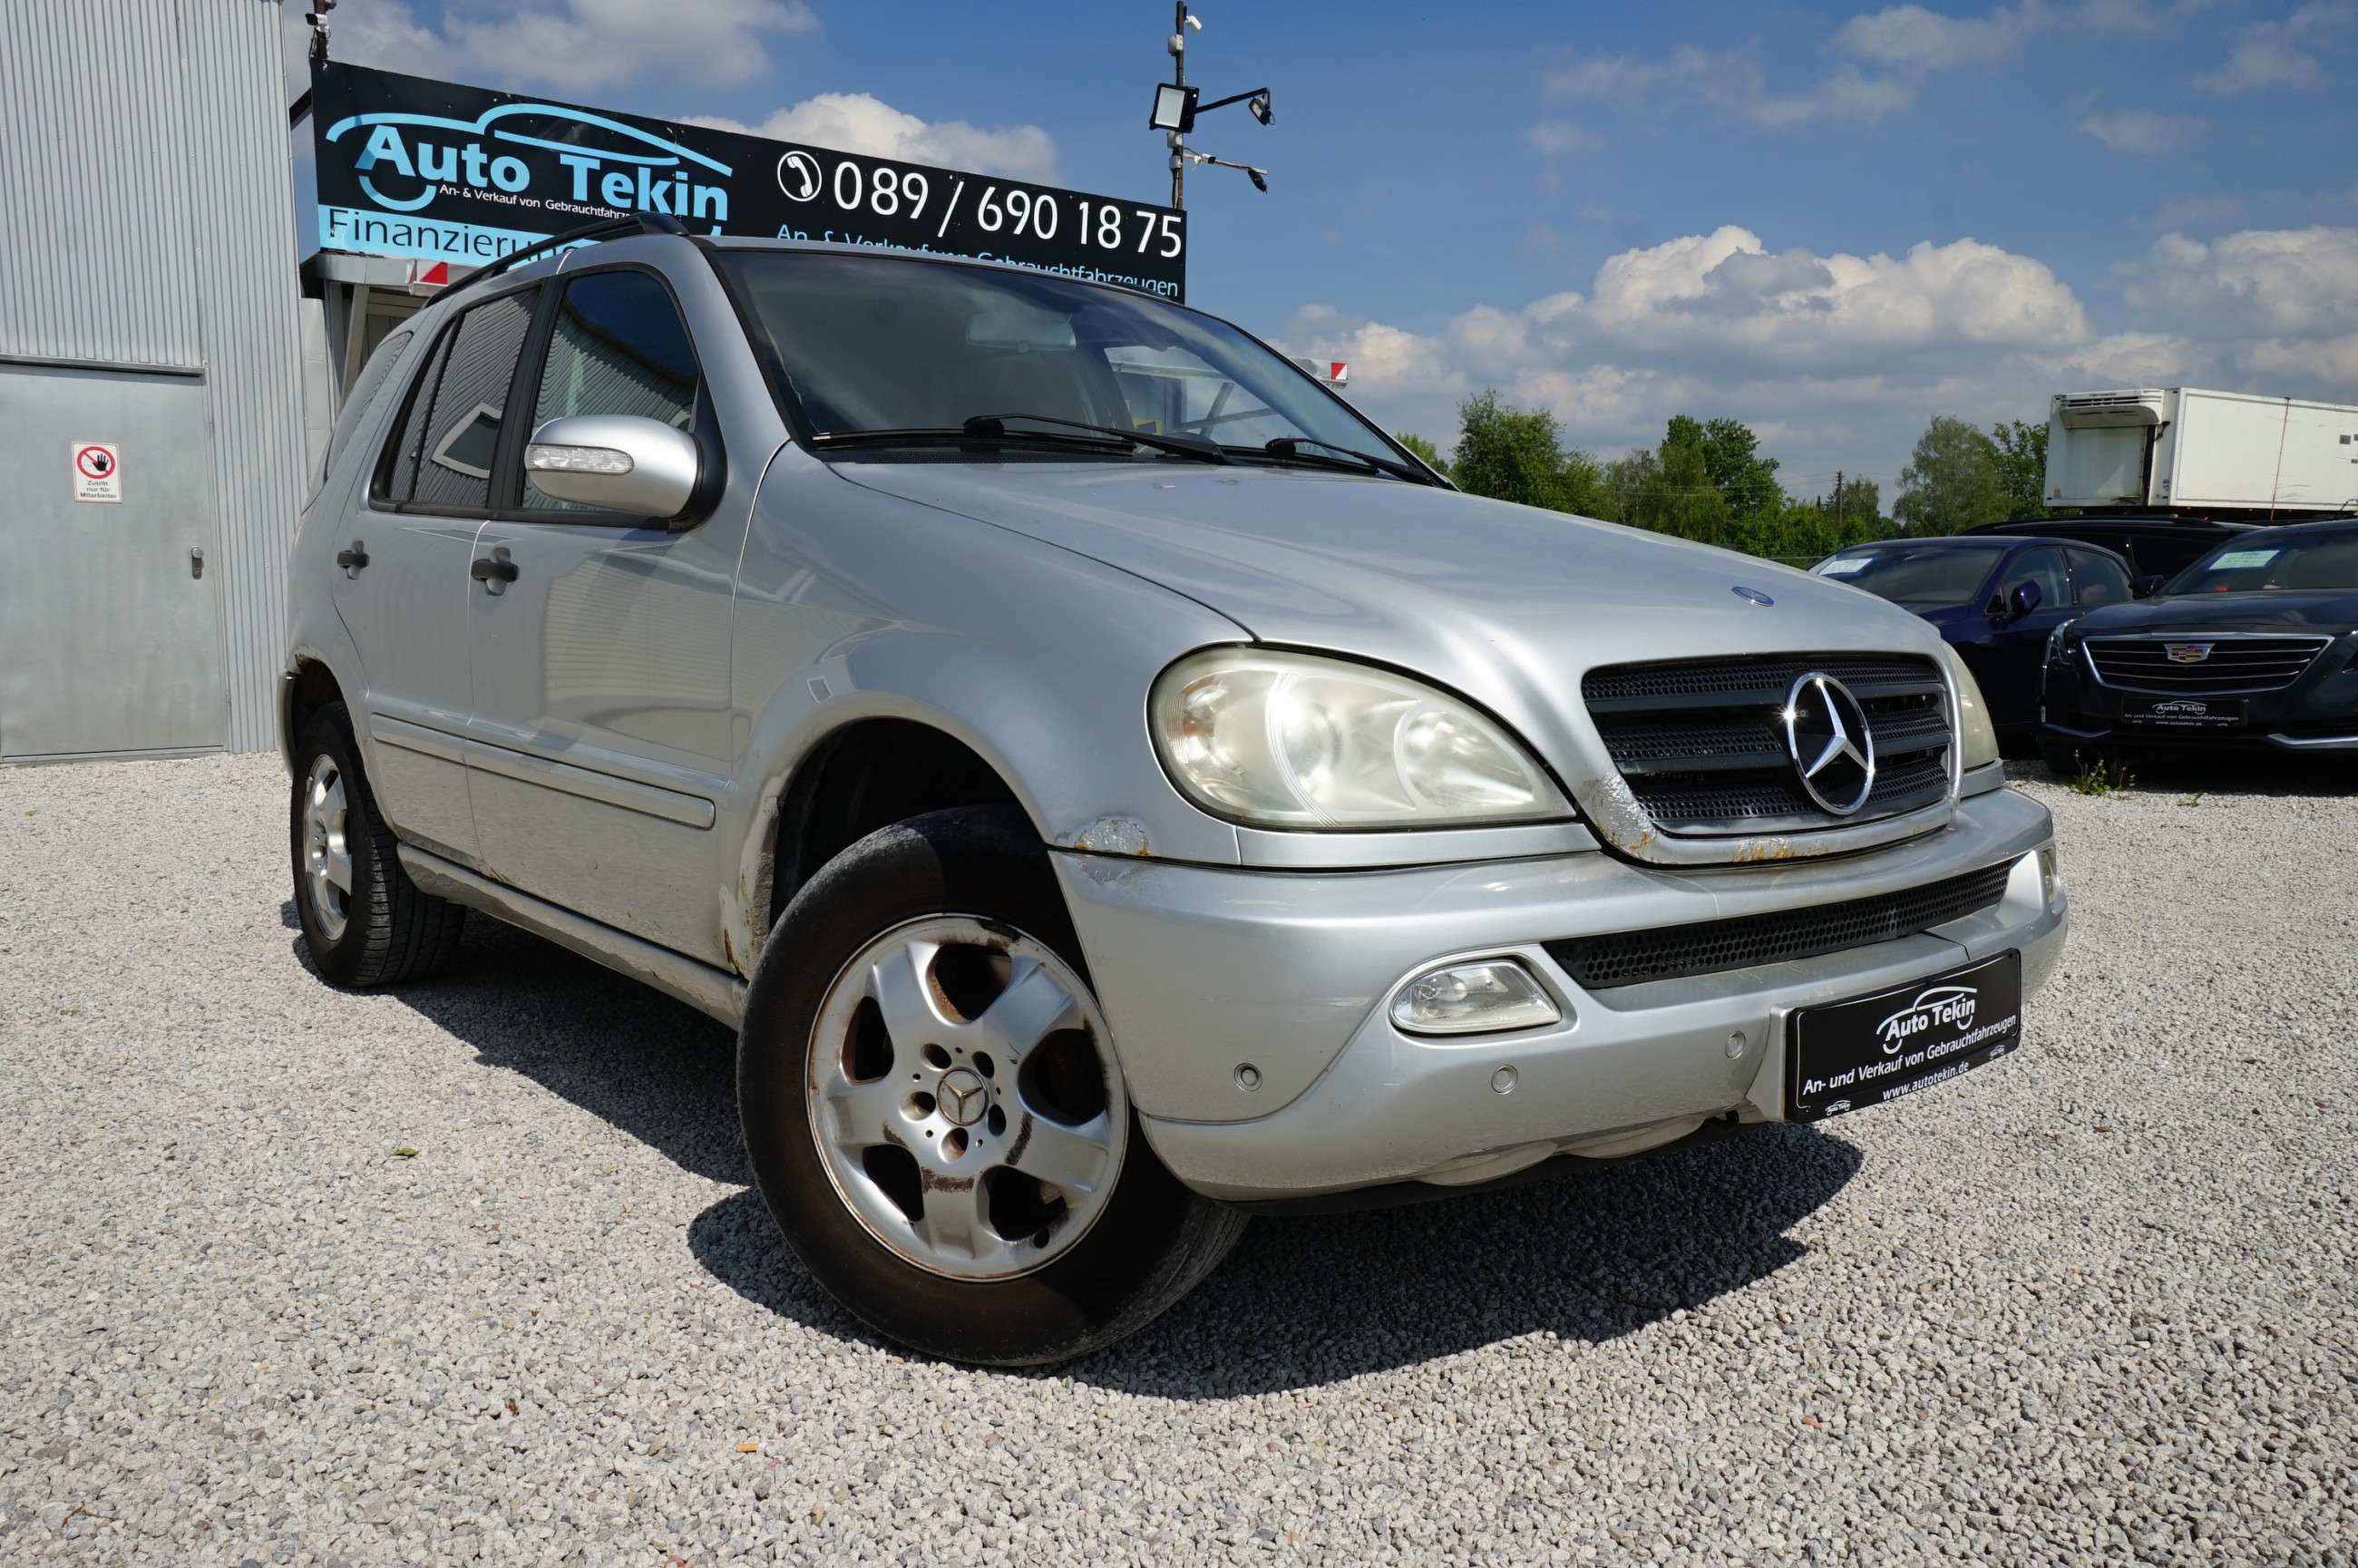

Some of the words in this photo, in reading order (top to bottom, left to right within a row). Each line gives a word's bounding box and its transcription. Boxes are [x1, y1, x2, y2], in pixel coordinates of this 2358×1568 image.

[355, 124, 531, 193] Auto
[559, 152, 728, 221] Tekin
[439, 184, 461, 196] An-
[463, 187, 472, 198] &
[474, 189, 518, 205] Verkauf
[520, 197, 541, 209] von
[833, 161, 930, 219] 089
[937, 180, 965, 239] /
[977, 186, 1059, 240] 690
[1078, 201, 1123, 249] 18
[1135, 209, 1183, 258] 75
[1885, 1014, 1929, 1042] Auto
[1932, 998, 1975, 1026] Tekin
[1802, 1078, 1827, 1096] An-
[1829, 1068, 1856, 1089] und
[1858, 1055, 1904, 1081] Verkauf
[1905, 1051, 1924, 1067] von
[1927, 1014, 2017, 1059] Gebrauchtfahrzeugen
[1882, 1060, 1970, 1101] www.autotekin.de
